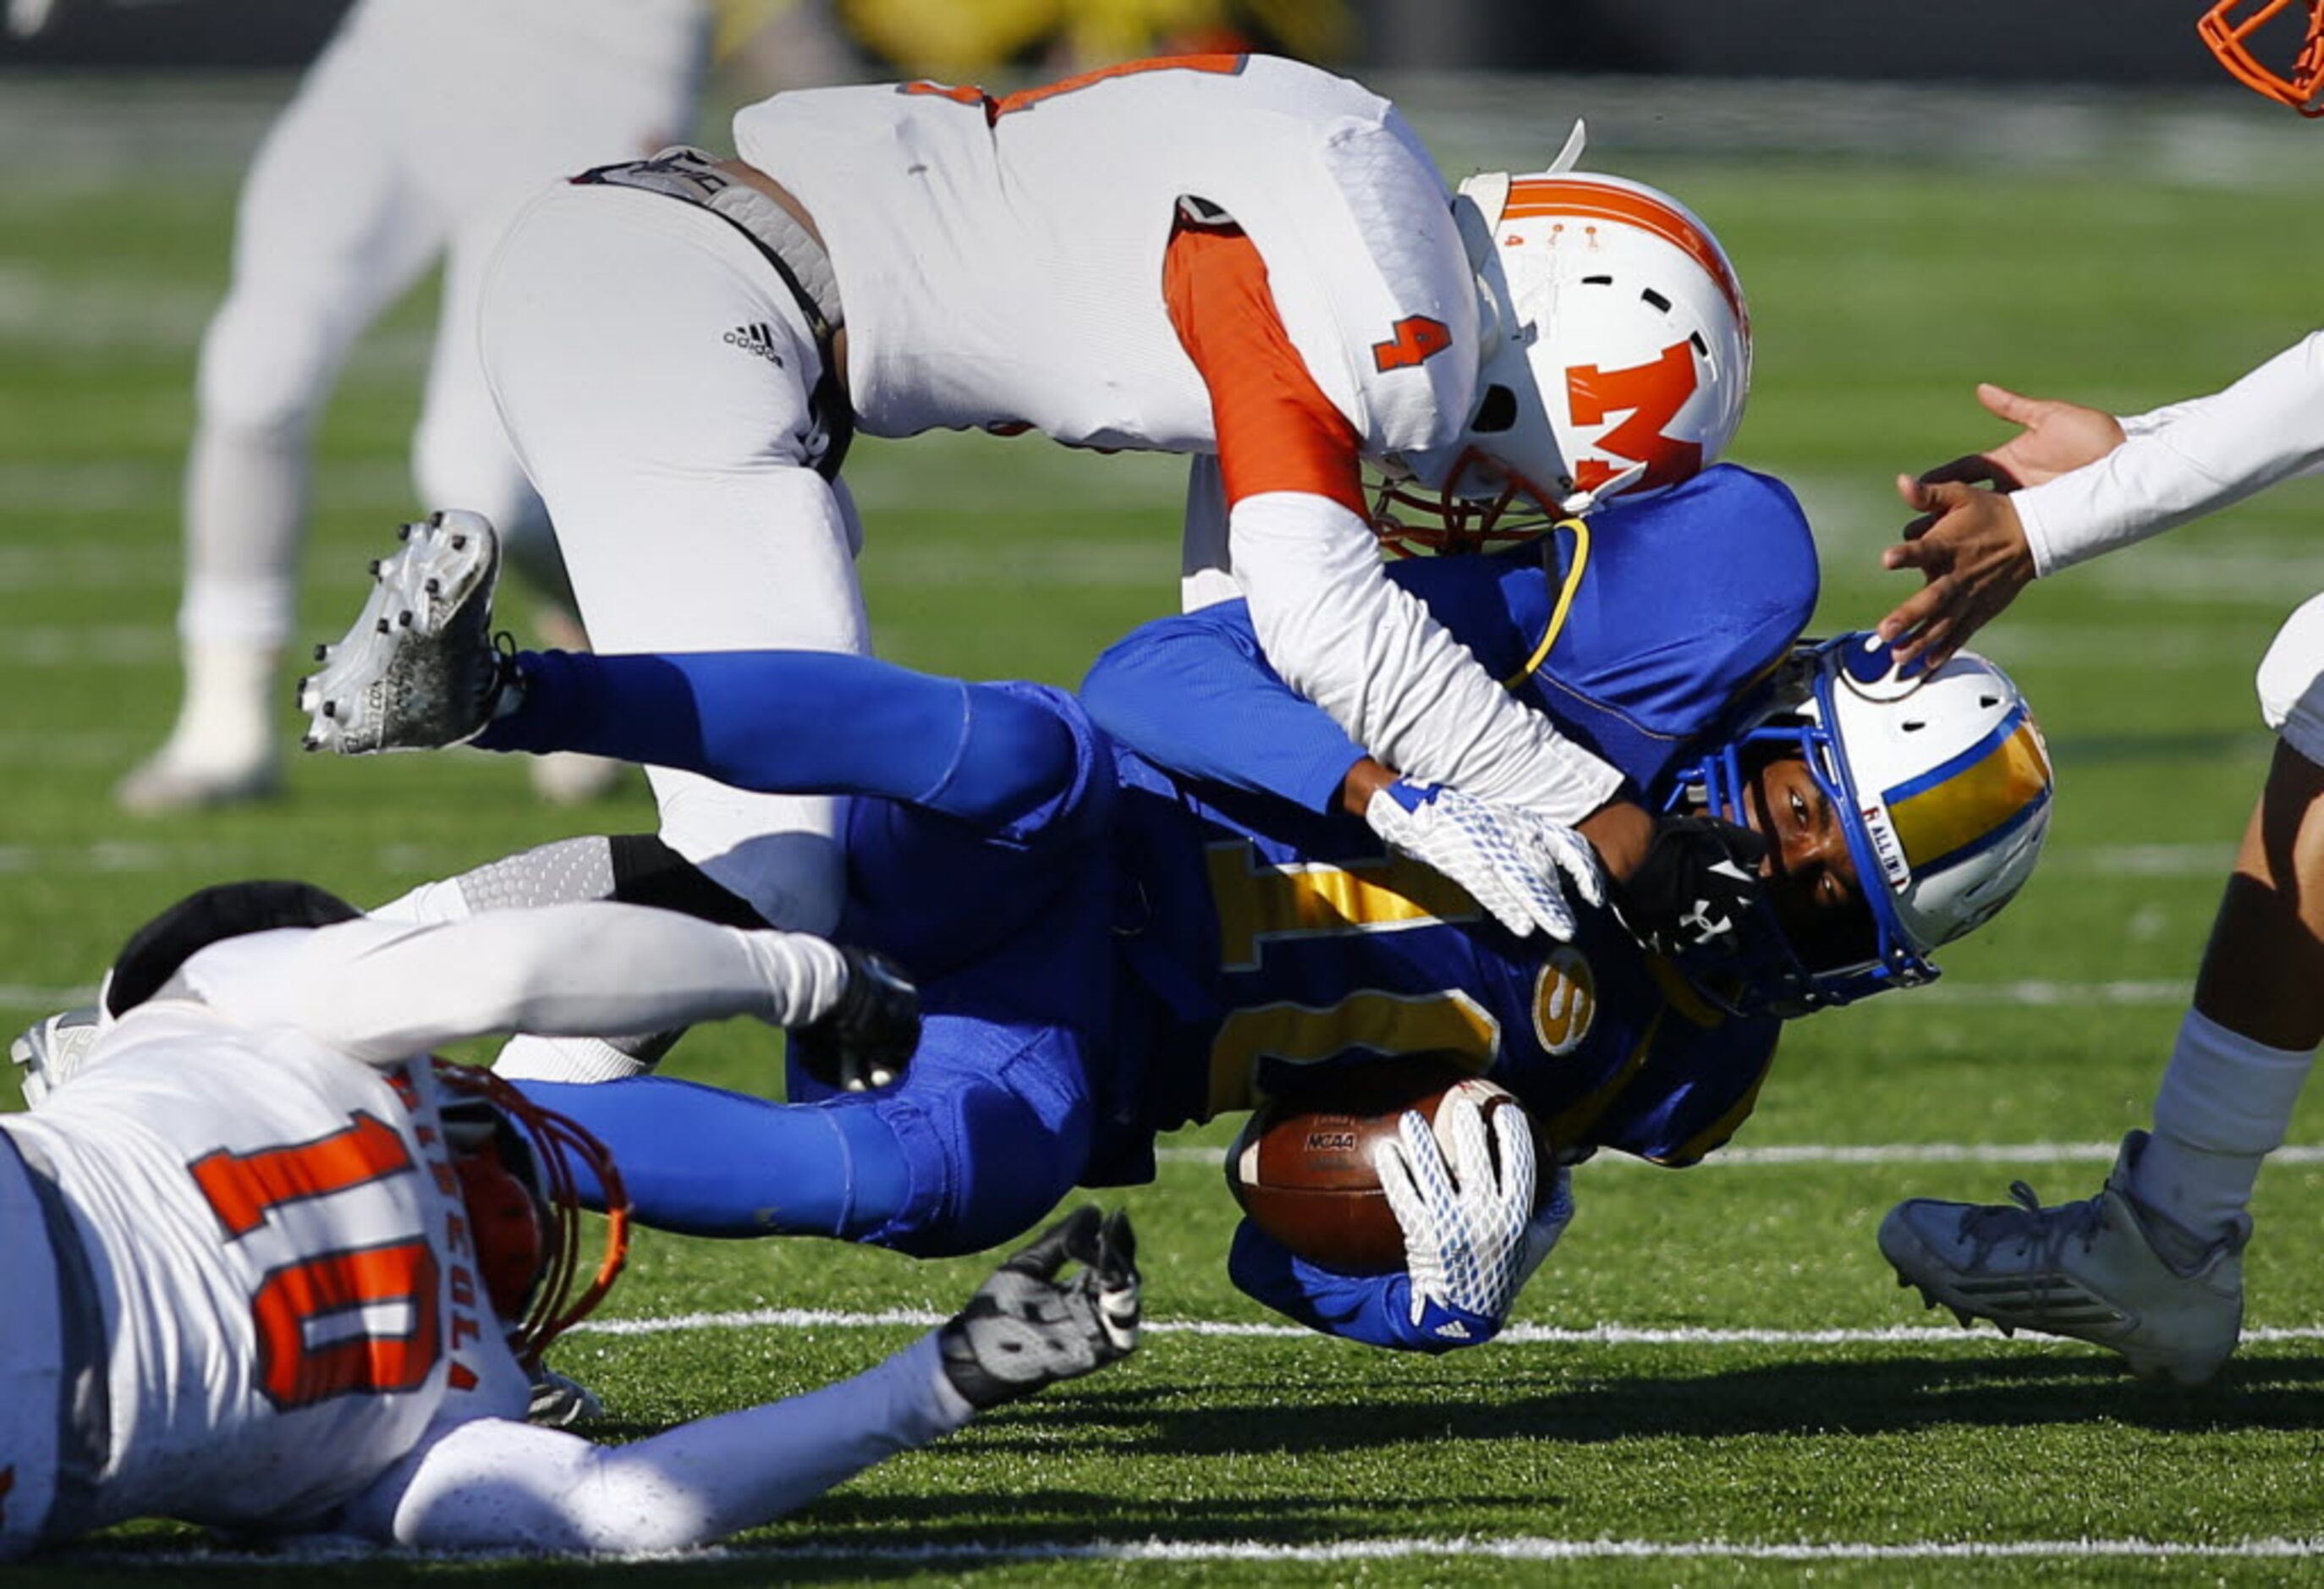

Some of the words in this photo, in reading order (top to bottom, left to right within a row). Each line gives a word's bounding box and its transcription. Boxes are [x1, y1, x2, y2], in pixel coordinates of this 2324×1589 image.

[1372, 314, 1453, 374] 4
[1564, 339, 1703, 497] M
[1871, 826, 1892, 854] ALL
[1307, 1131, 1355, 1152] NCAA
[187, 1108, 444, 1416] 10
